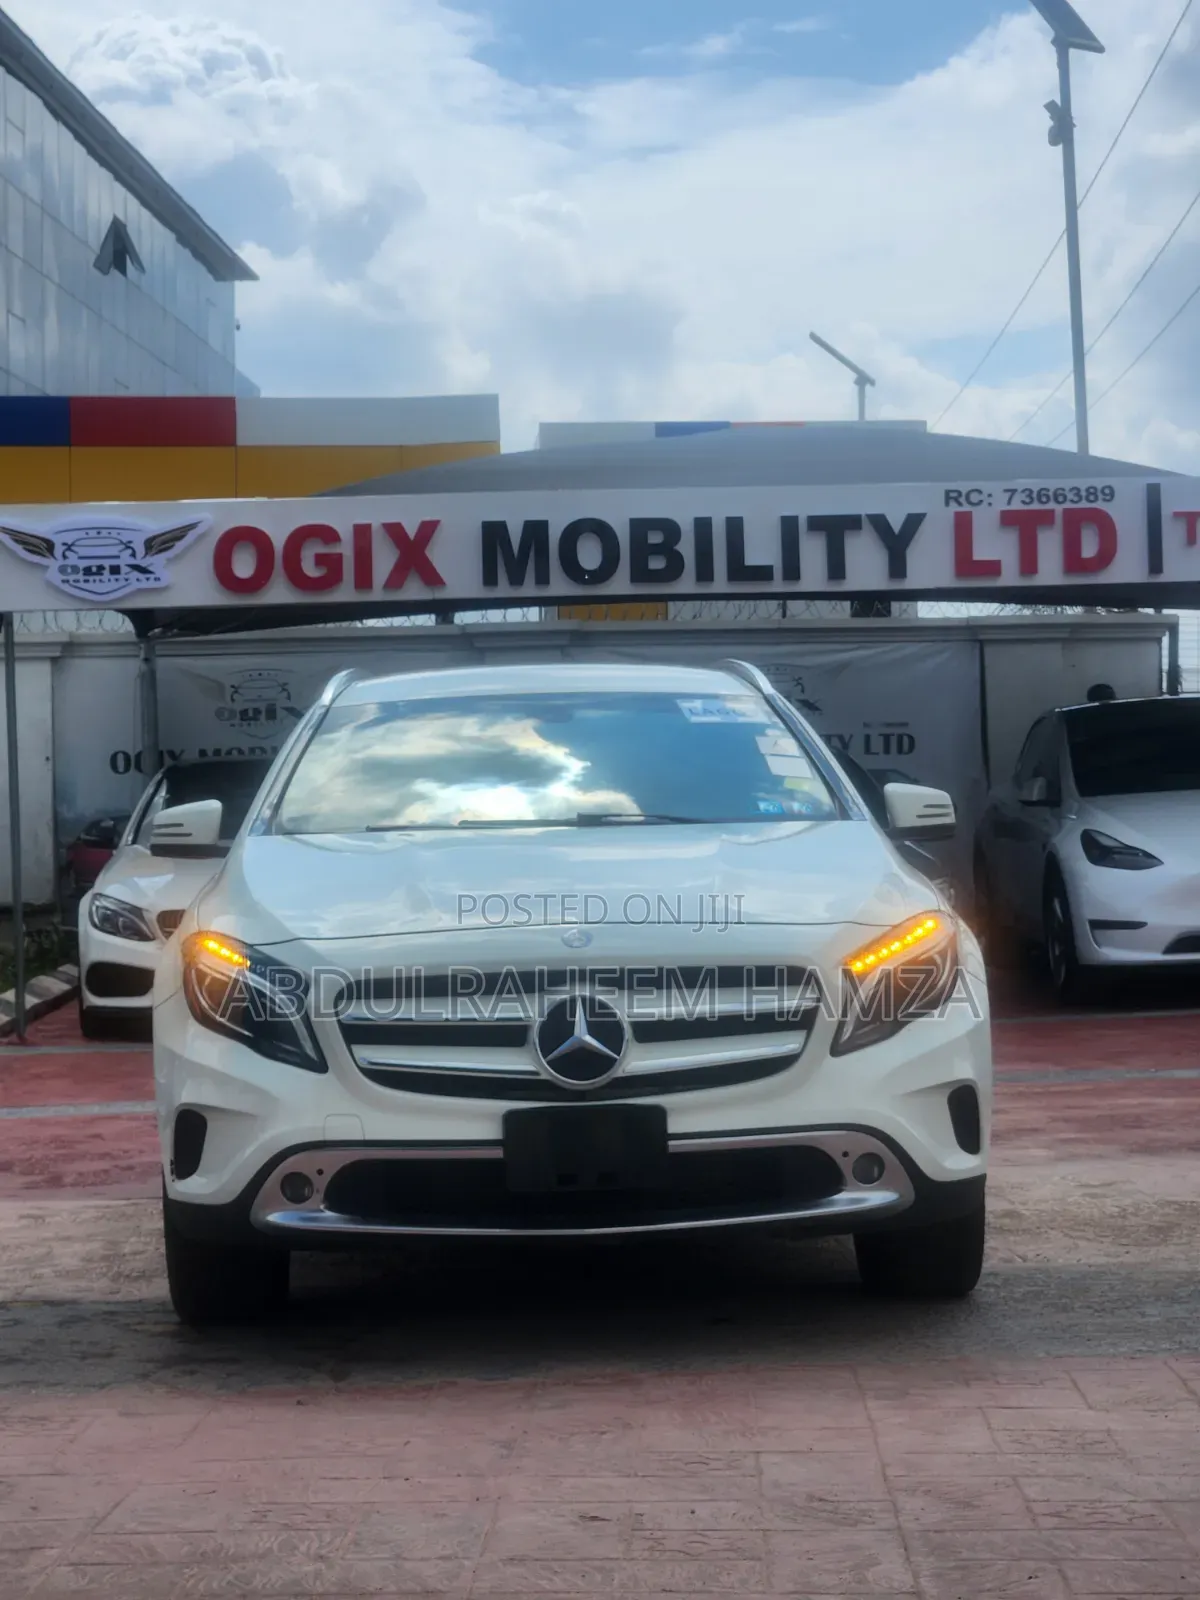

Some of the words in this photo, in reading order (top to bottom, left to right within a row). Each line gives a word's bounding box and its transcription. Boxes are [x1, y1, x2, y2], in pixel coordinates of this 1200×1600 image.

[944, 488, 993, 507] RC:
[1003, 485, 1115, 506] 7366389
[213, 519, 447, 594] OGIX
[481, 512, 928, 586] MOBILITY
[953, 507, 1118, 578] LTD
[863, 733, 916, 755] LTD
